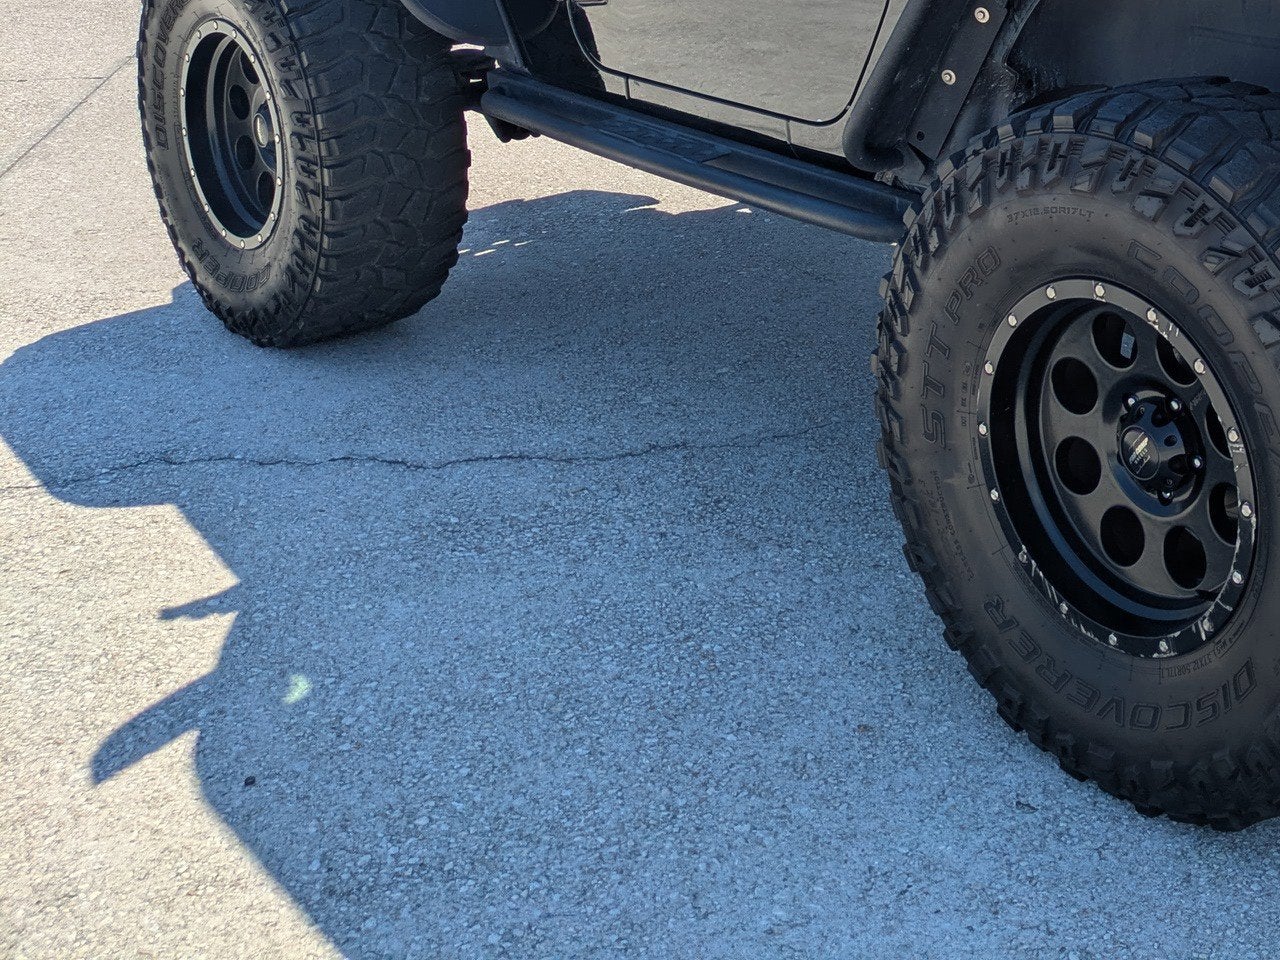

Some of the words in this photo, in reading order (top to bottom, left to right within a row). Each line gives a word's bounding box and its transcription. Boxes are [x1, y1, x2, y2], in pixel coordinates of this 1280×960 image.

[192, 237, 272, 293] COOPER
[920, 321, 951, 450] STT
[943, 245, 1001, 325] PRO
[984, 595, 1257, 732] DISCOVERER
